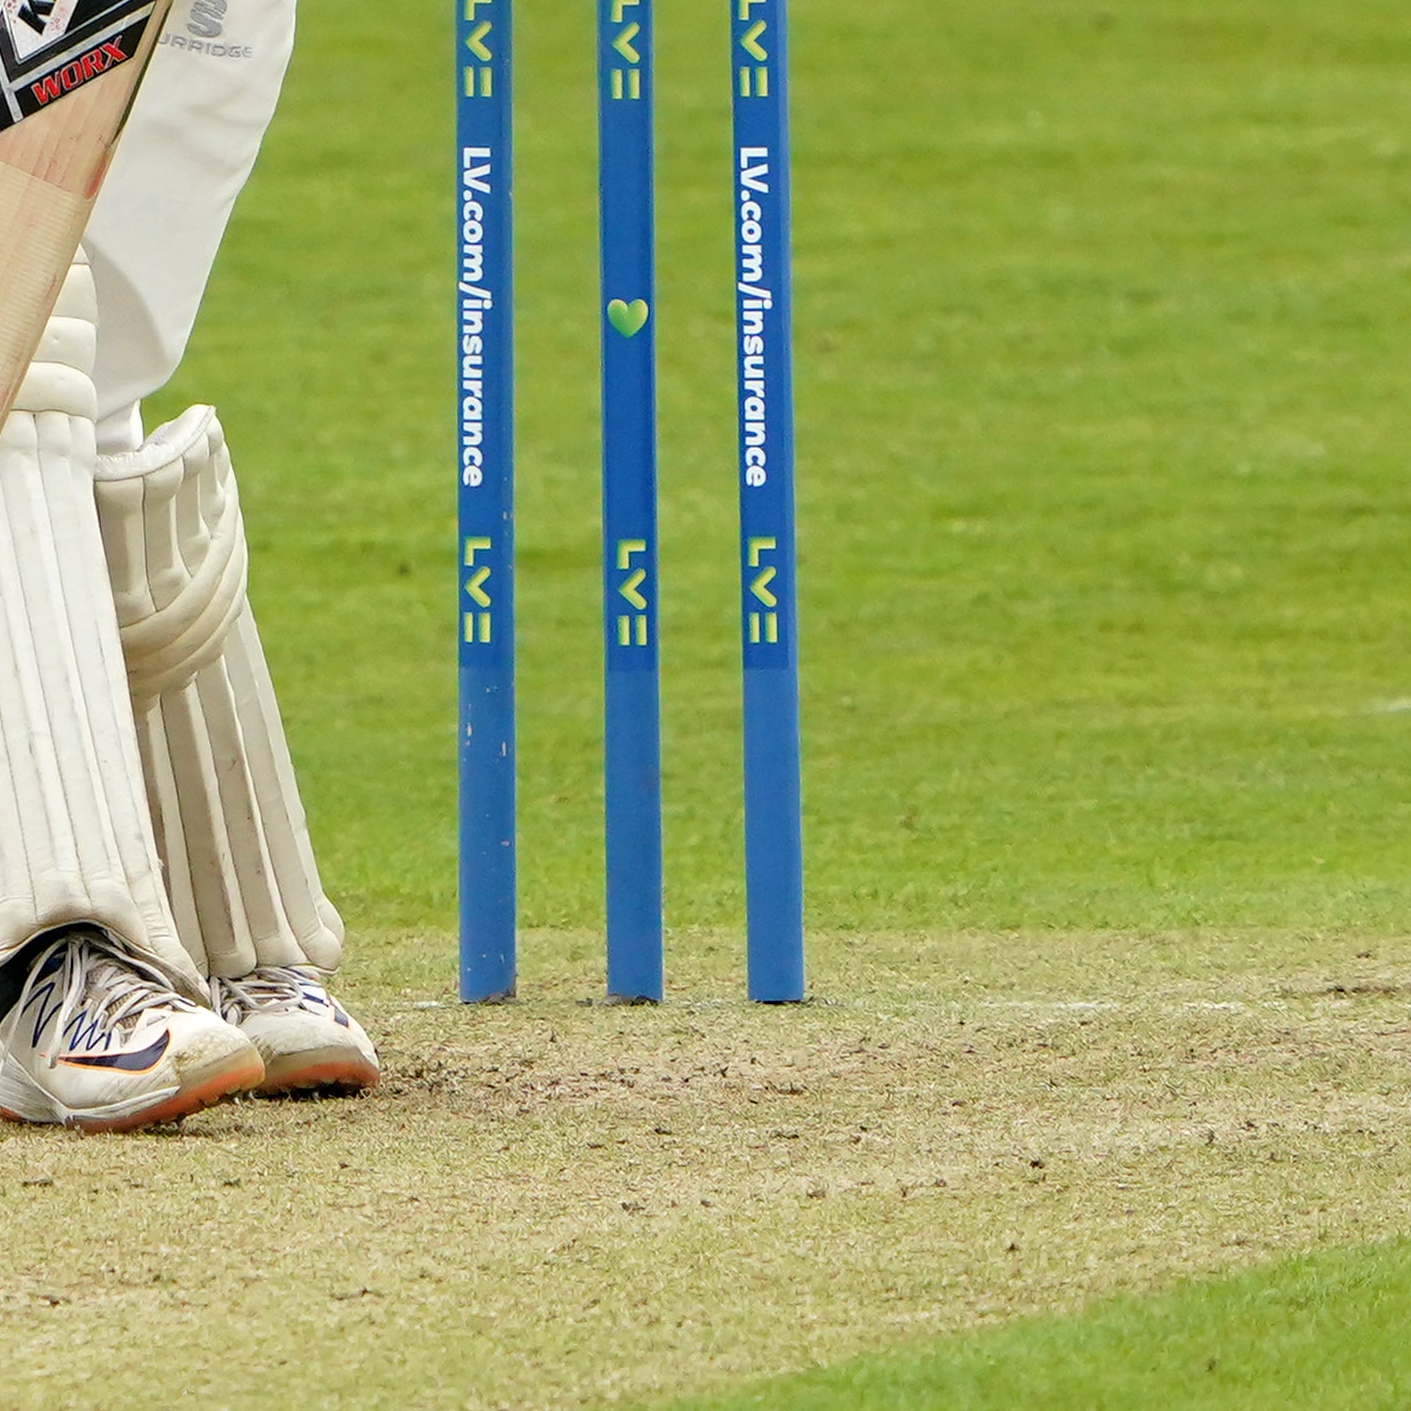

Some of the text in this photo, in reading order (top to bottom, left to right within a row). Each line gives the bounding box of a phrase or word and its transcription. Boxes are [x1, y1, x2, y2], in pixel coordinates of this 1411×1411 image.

[31, 35, 128, 105] WORX
[458, 146, 493, 487] LV.com/insurance
[738, 146, 772, 487] LV.com/insurance
